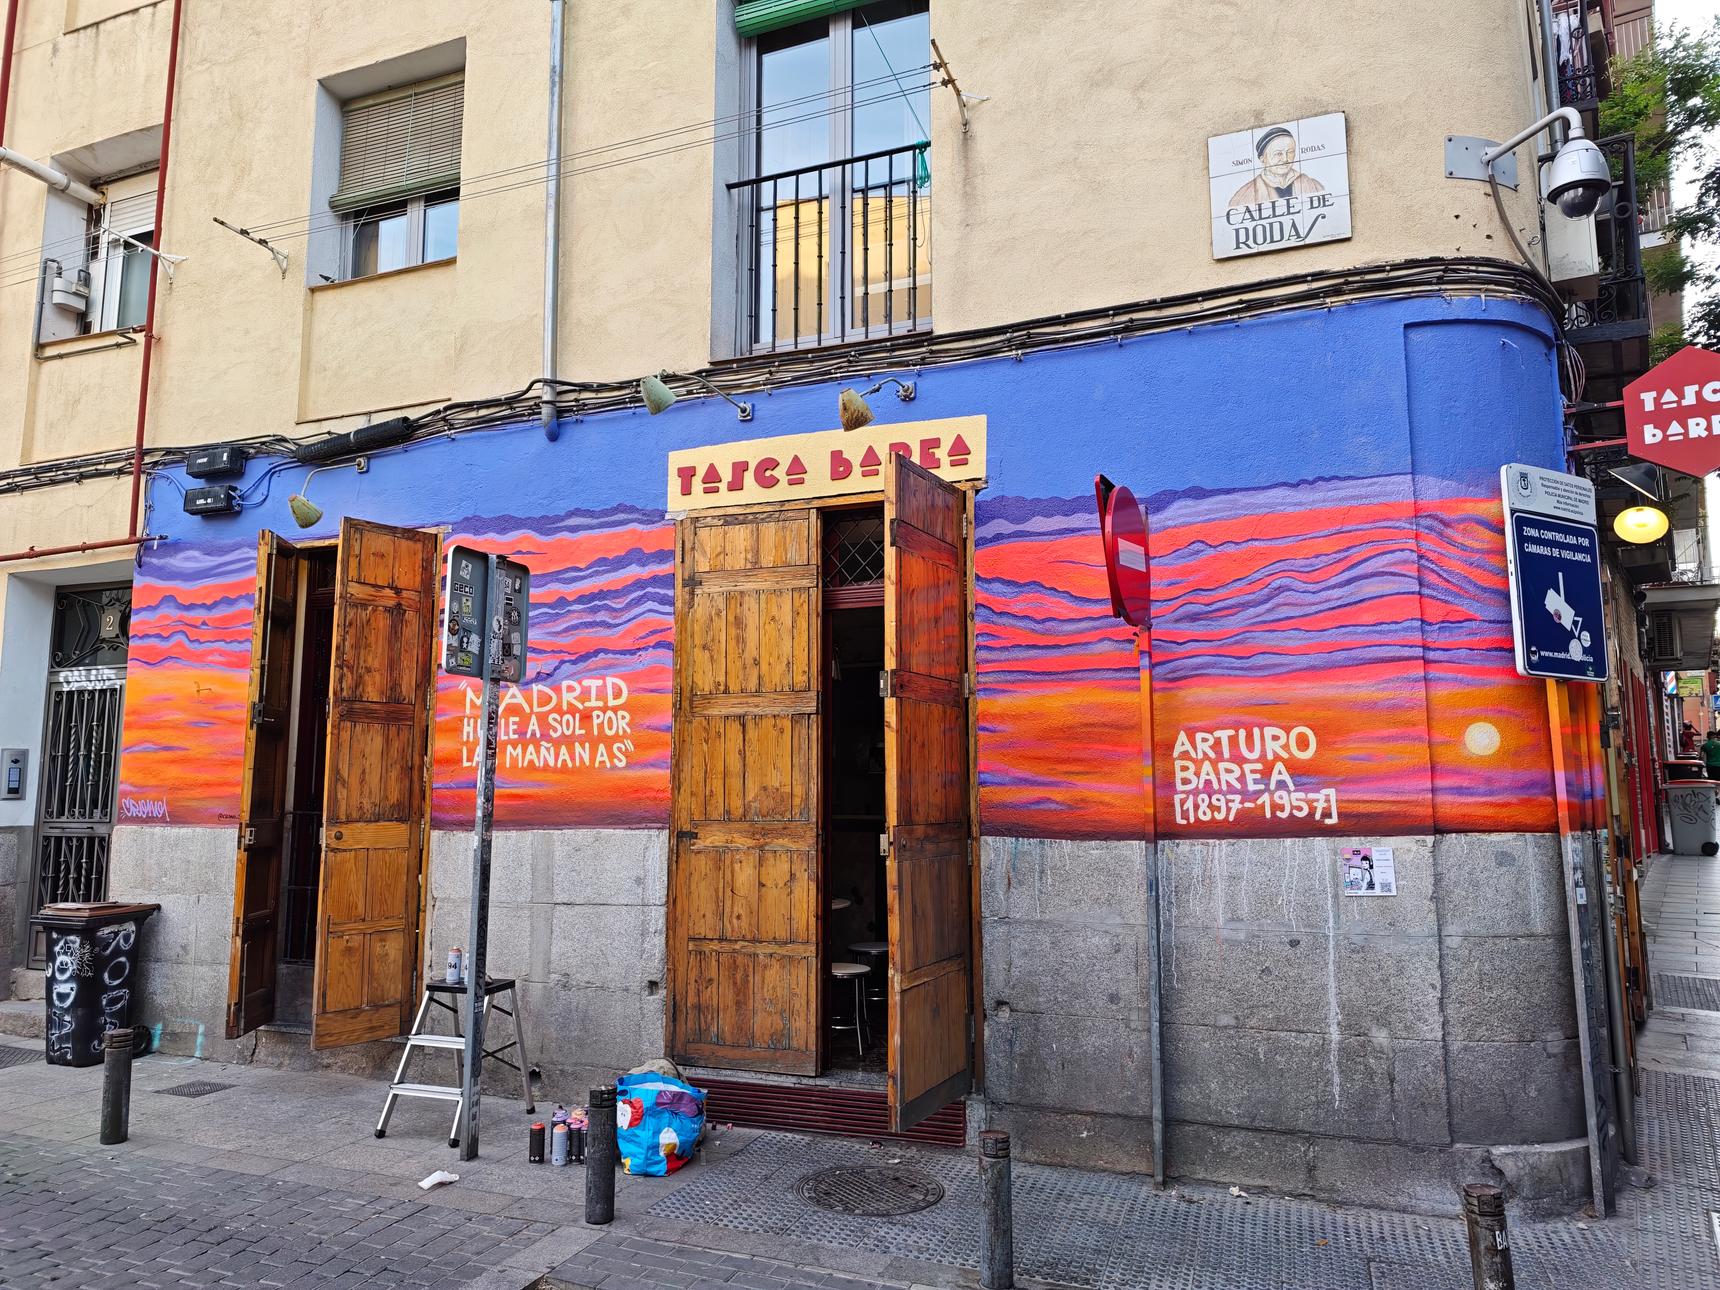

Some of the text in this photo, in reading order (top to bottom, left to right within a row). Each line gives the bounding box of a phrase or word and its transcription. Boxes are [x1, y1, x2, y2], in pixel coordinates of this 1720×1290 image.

[1301, 144, 1326, 154] RODAS
[1226, 193, 1335, 226] CALLE DE
[1233, 213, 1326, 250] RODAS
[676, 454, 808, 496] TASCA
[1522, 526, 1590, 547] ZONA CONTROLADA POR
[1552, 548, 1560, 557] DE
[1560, 549, 1591, 563] VIGILANCIA
[106, 615, 114, 630] 2
[526, 714, 541, 738] A
[548, 712, 586, 738] SOL
[592, 710, 632, 736] POR
[1173, 725, 1317, 760] ARTURO
[1174, 760, 1295, 791] BAREA
[1174, 788, 1338, 824] [1897-1957]
